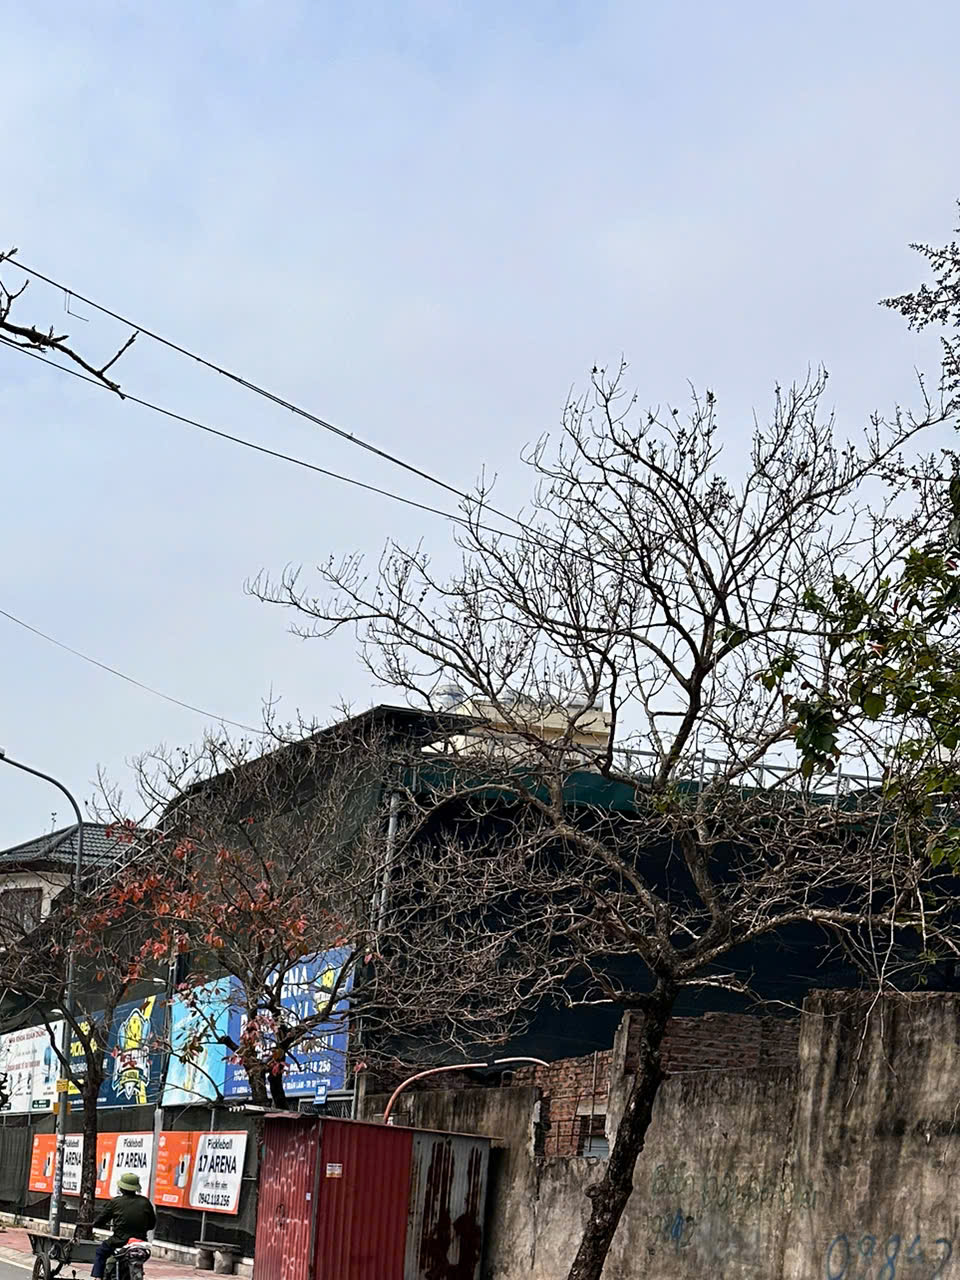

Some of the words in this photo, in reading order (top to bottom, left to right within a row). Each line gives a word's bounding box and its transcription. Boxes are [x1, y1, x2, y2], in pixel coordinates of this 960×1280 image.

[207, 1138, 233, 1150] Pickleball
[65, 1151, 82, 1167] ARENA
[117, 1152, 125, 1168] 17
[124, 1152, 148, 1169] ARENA
[198, 1154, 208, 1173] 17
[208, 1154, 237, 1175] ARENA
